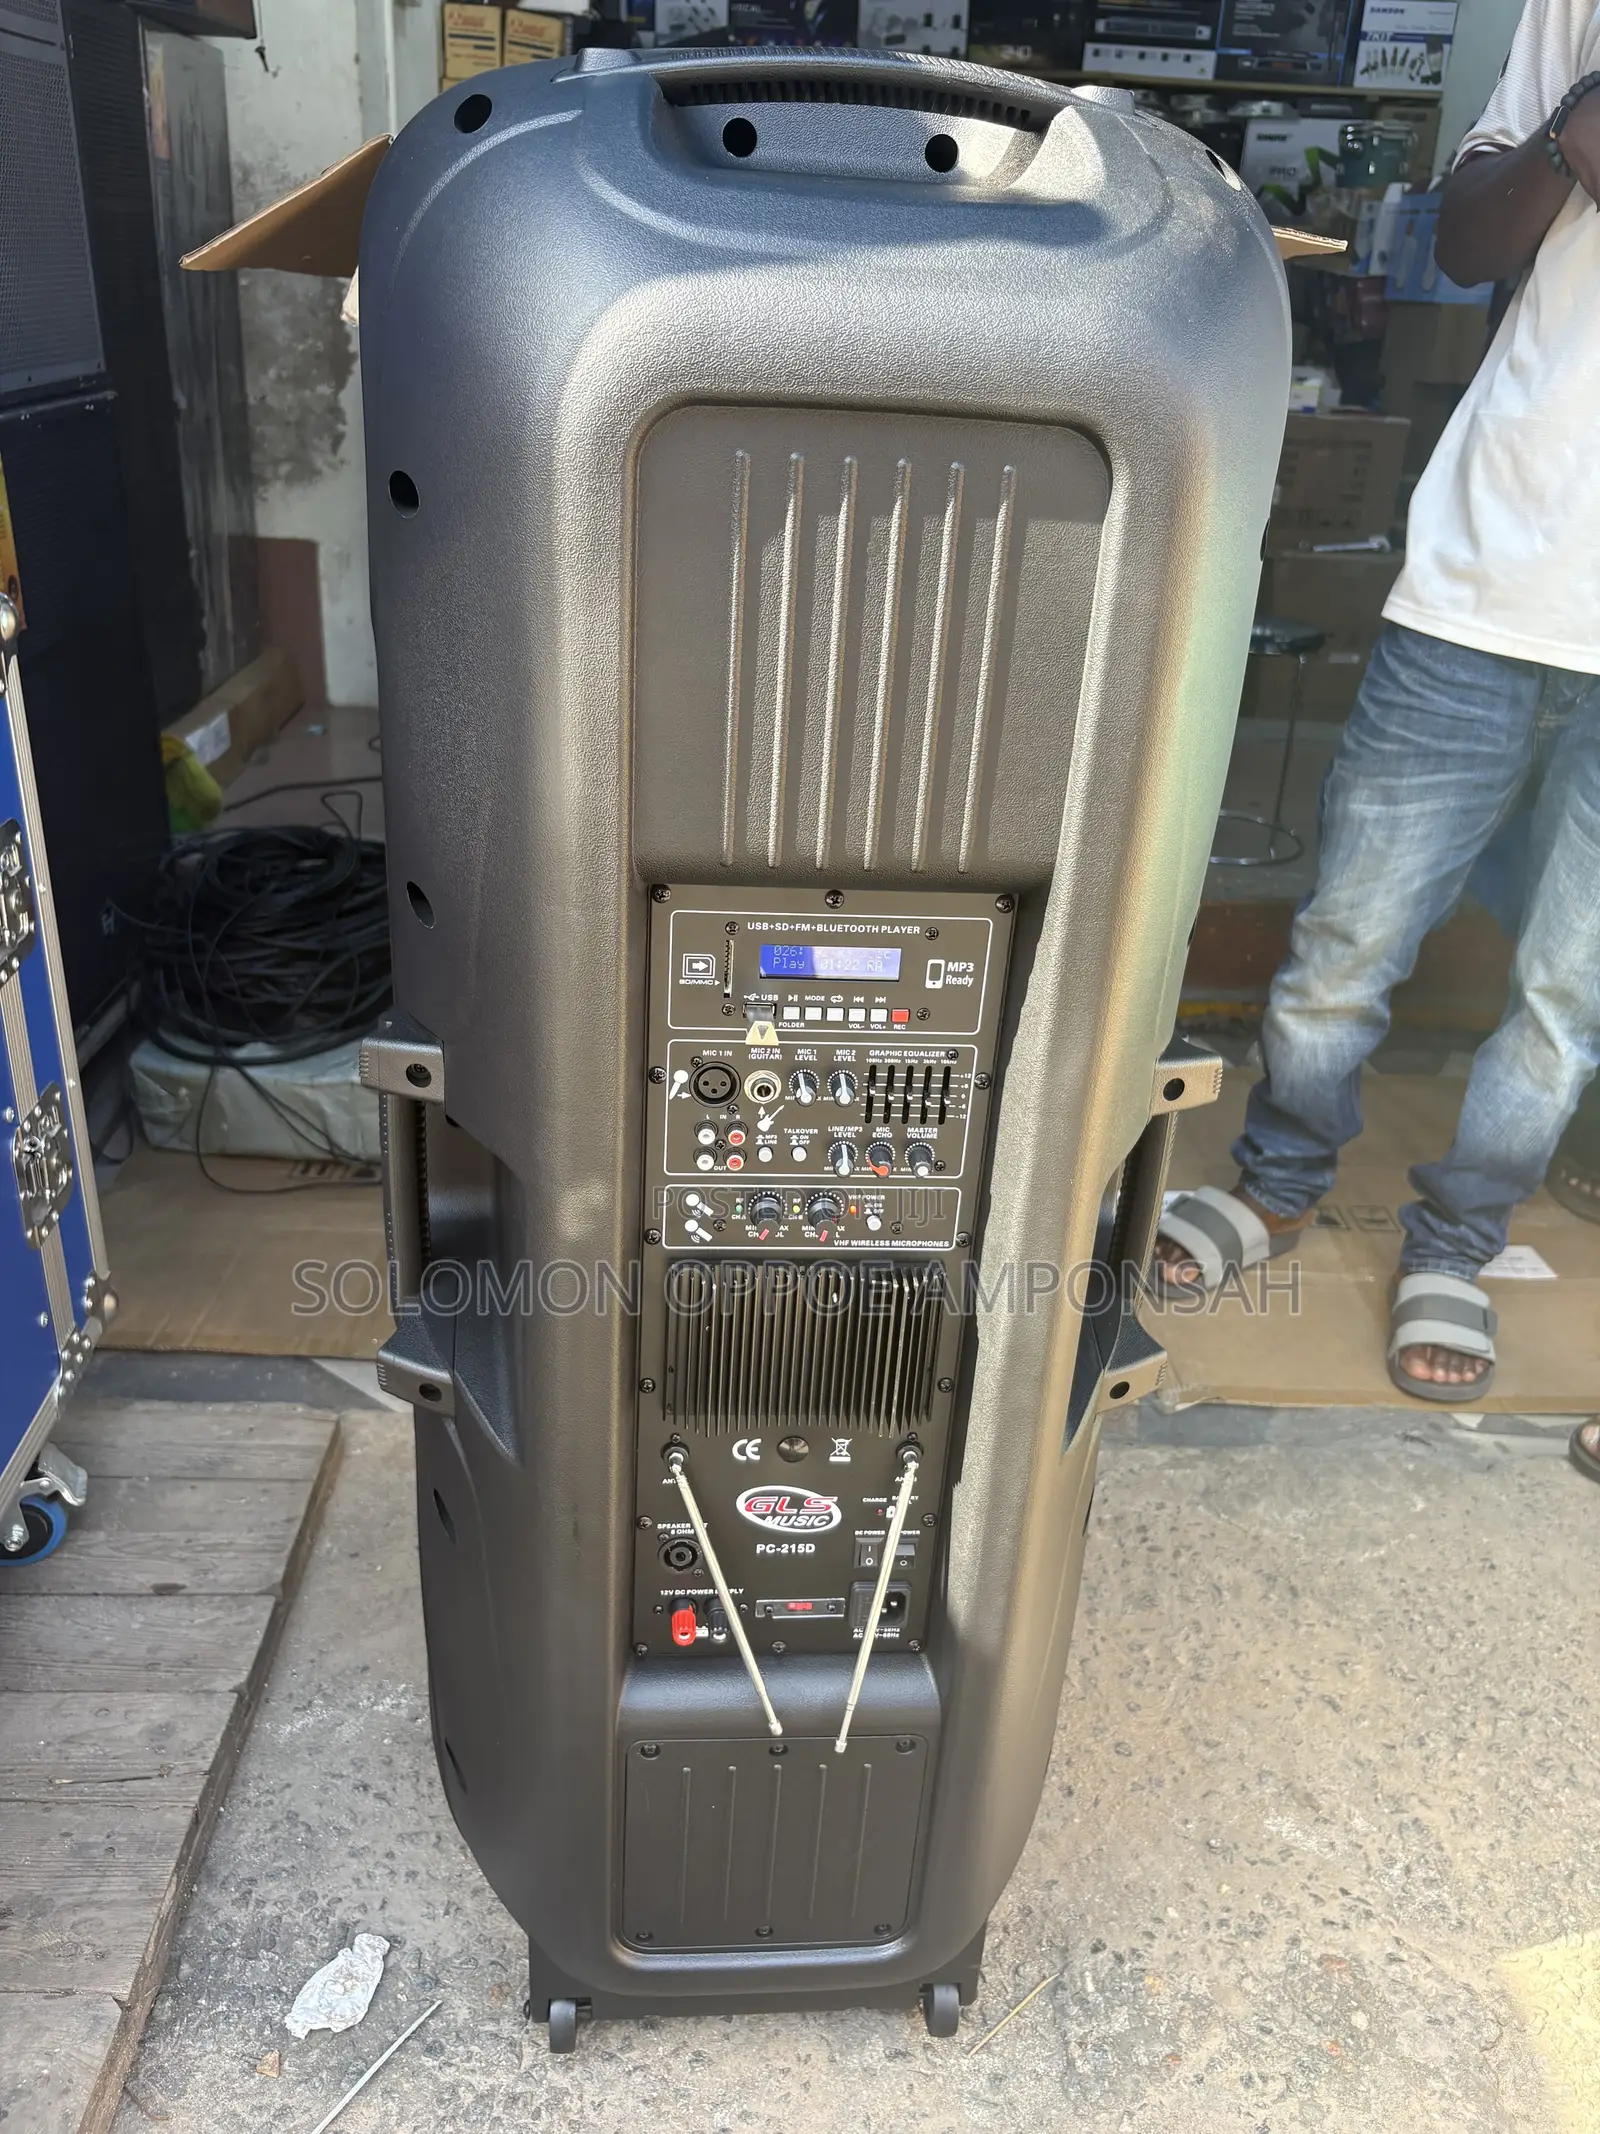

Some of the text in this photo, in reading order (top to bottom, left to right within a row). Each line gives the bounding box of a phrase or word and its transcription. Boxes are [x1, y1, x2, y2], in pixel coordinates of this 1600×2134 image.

[747, 921, 921, 935] USB+SD+FM+BLUETOOTH PLAYER
[773, 957, 805, 969] Play
[947, 961, 975, 973] MP3
[945, 974, 974, 988] Ready
[761, 993, 779, 1001] USB
[804, 994, 826, 1002] MODE
[869, 1049, 946, 1058] GRAPHIC EQUALIZER
[833, 1239, 850, 1247] VHF
[891, 1240, 950, 1248] MICROPHONES
[732, 1438, 762, 1461] CE
[744, 1496, 839, 1514] GLS
[657, 1522, 691, 1530] SPEAKER
[763, 1514, 830, 1527] MUSIC
[755, 1543, 816, 1554] PC-215D
